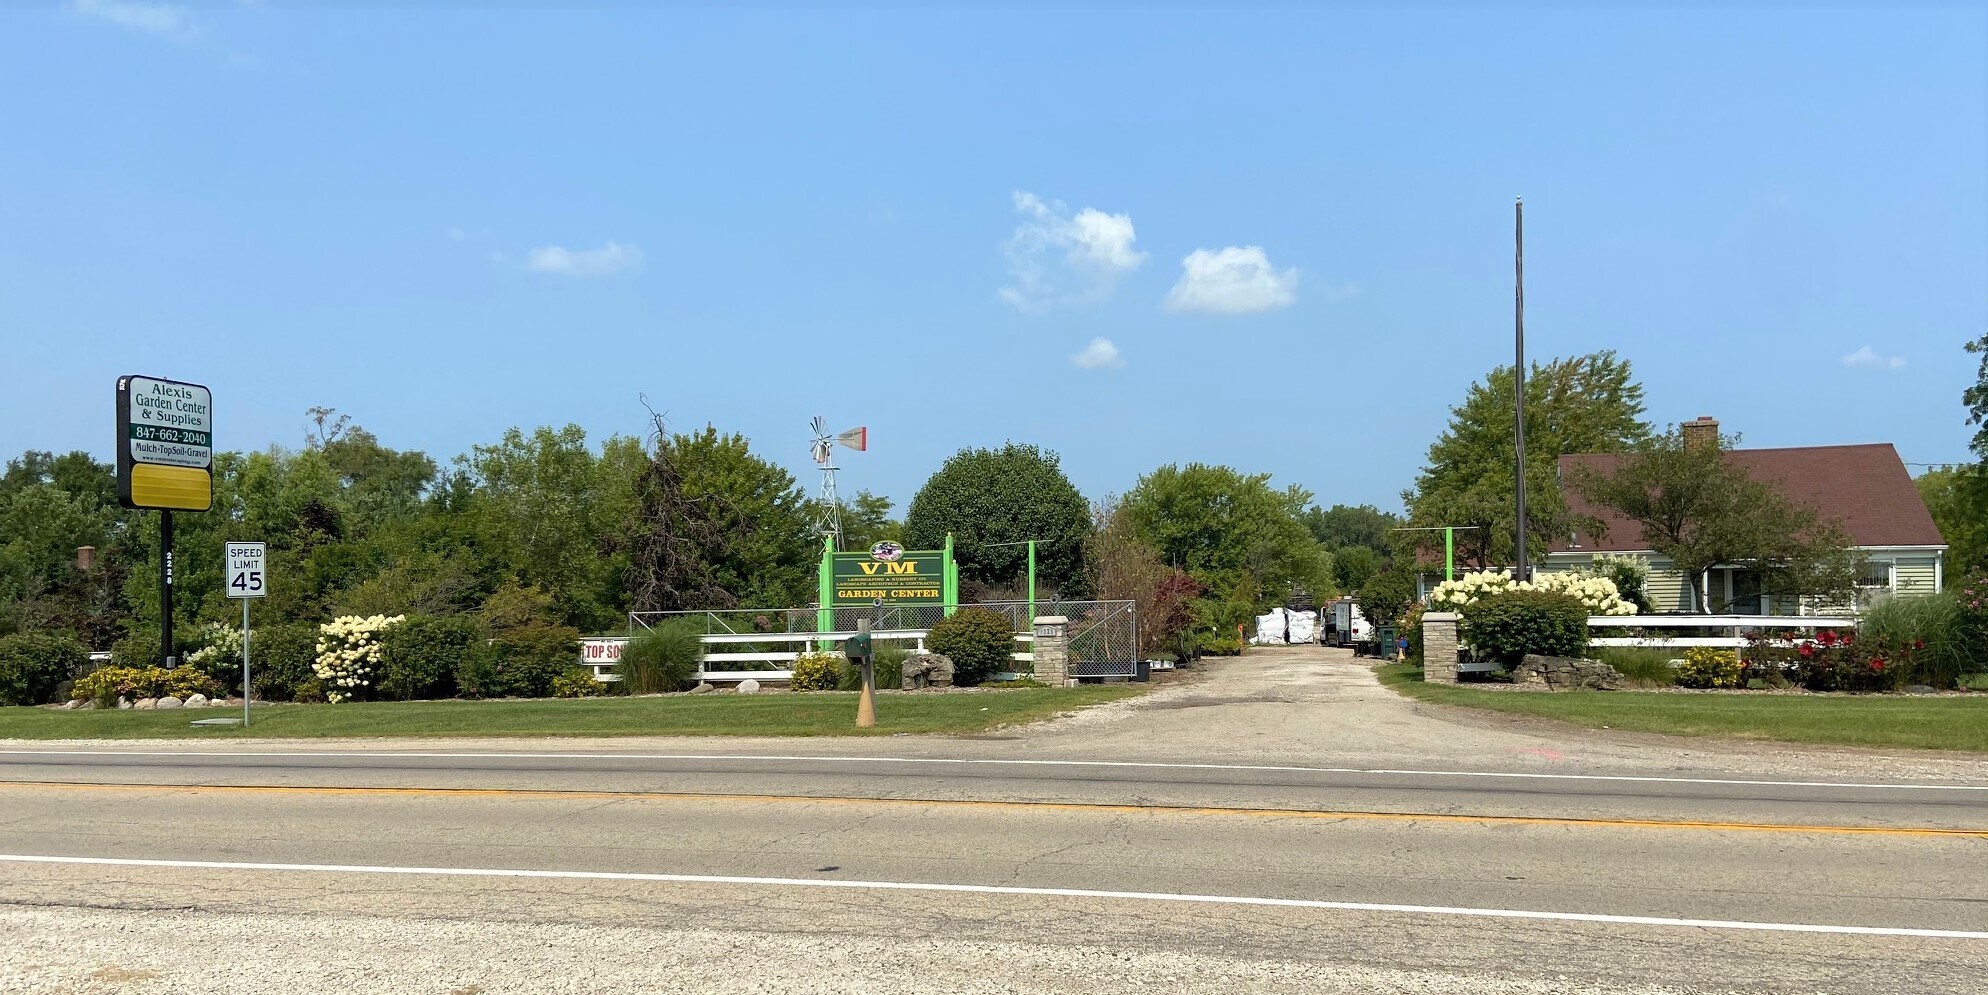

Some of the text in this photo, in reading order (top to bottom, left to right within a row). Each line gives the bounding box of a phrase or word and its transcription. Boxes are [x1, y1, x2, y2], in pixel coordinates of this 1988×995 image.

[152, 383, 192, 399] Alexis
[135, 393, 206, 415] Garden Center
[141, 408, 202, 426] & Supplies
[136, 426, 206, 444] 847-662-2040
[230, 549, 263, 558] SPEED
[234, 560, 259, 569] LIMIT
[858, 561, 918, 575] VM
[231, 571, 263, 591] 45
[838, 589, 940, 598] GARDEN CENTER
[585, 644, 623, 658] TOP SO
